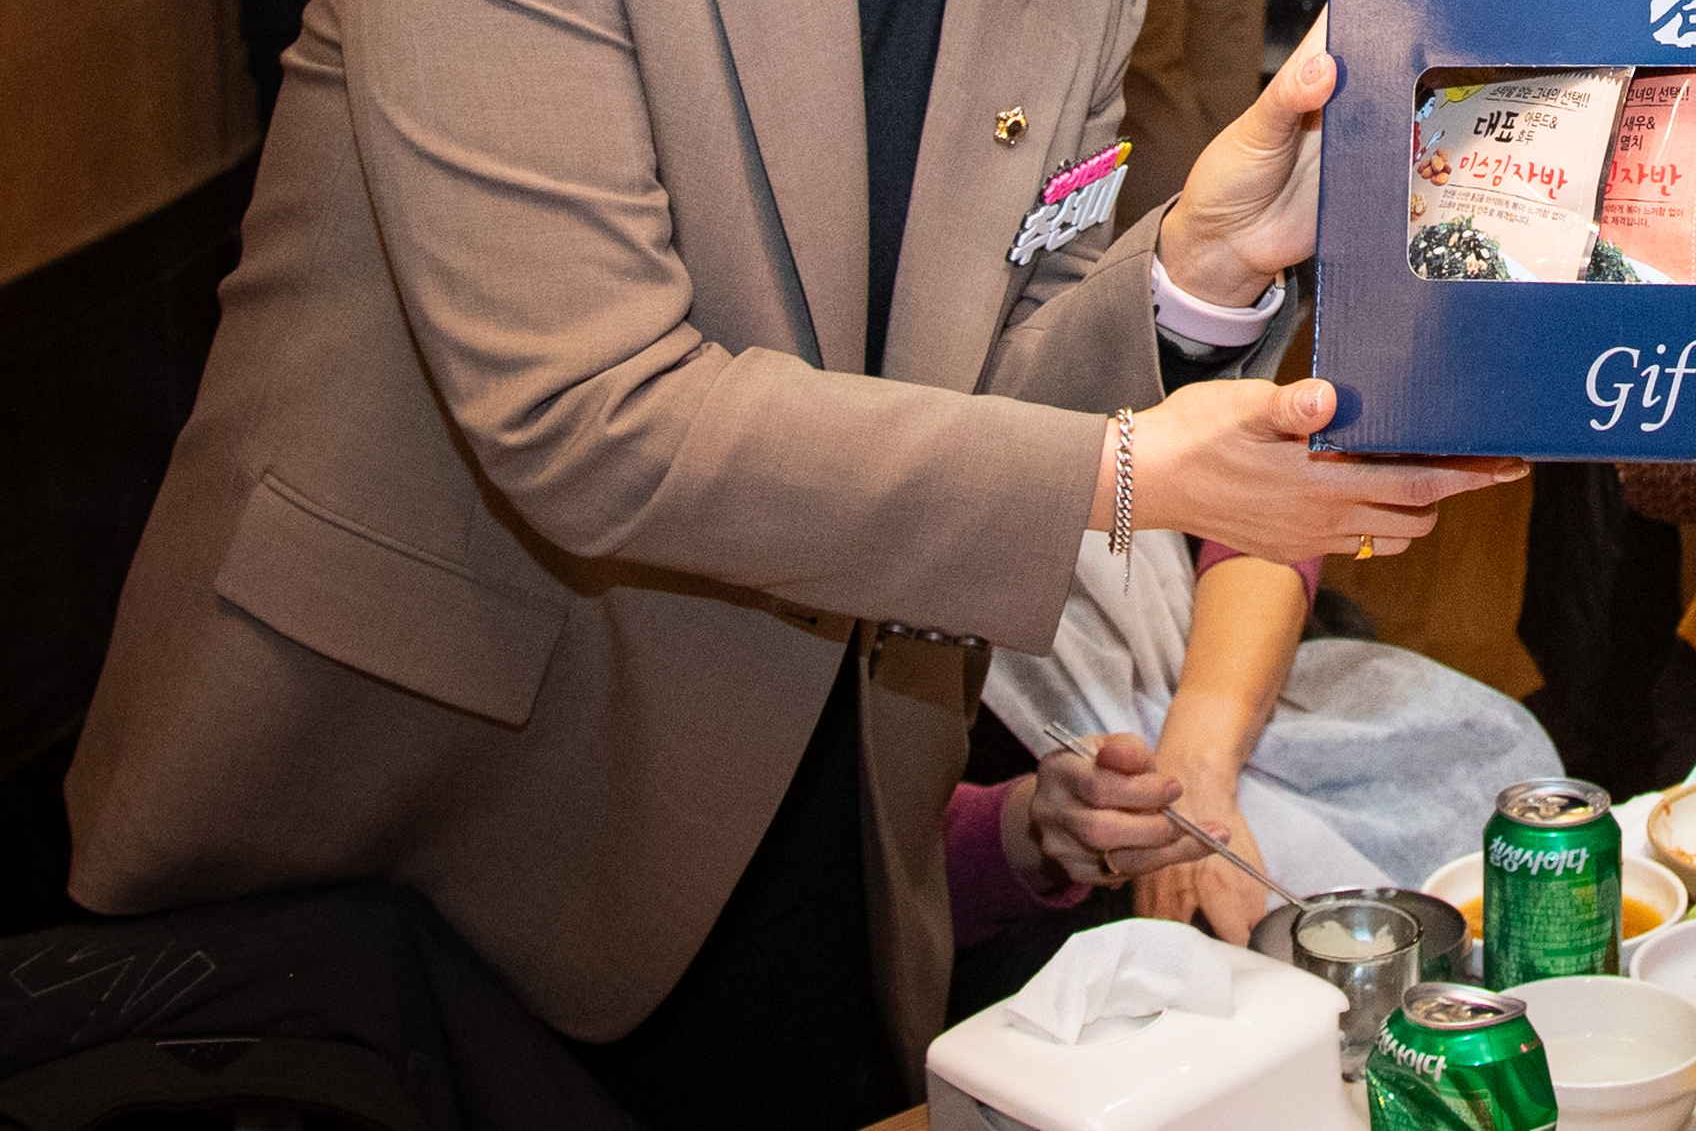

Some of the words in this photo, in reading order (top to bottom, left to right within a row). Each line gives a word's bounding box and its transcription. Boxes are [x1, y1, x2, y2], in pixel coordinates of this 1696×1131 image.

[1531, 87, 1560, 103] 그녀의
[1560, 90, 1591, 108] 선택!!
[1473, 110, 1519, 143] 대표
[1524, 111, 1558, 130] 아몬드&
[1622, 116, 1656, 131] 새우&
[1515, 130, 1535, 146] 호두
[1620, 135, 1643, 151] 멸치
[1459, 152, 1568, 200] 미스김자반
[1551, 210, 1567, 223] 없이
[1668, 207, 1684, 218] 없이
[1489, 835, 1590, 876] 칠성사이다
